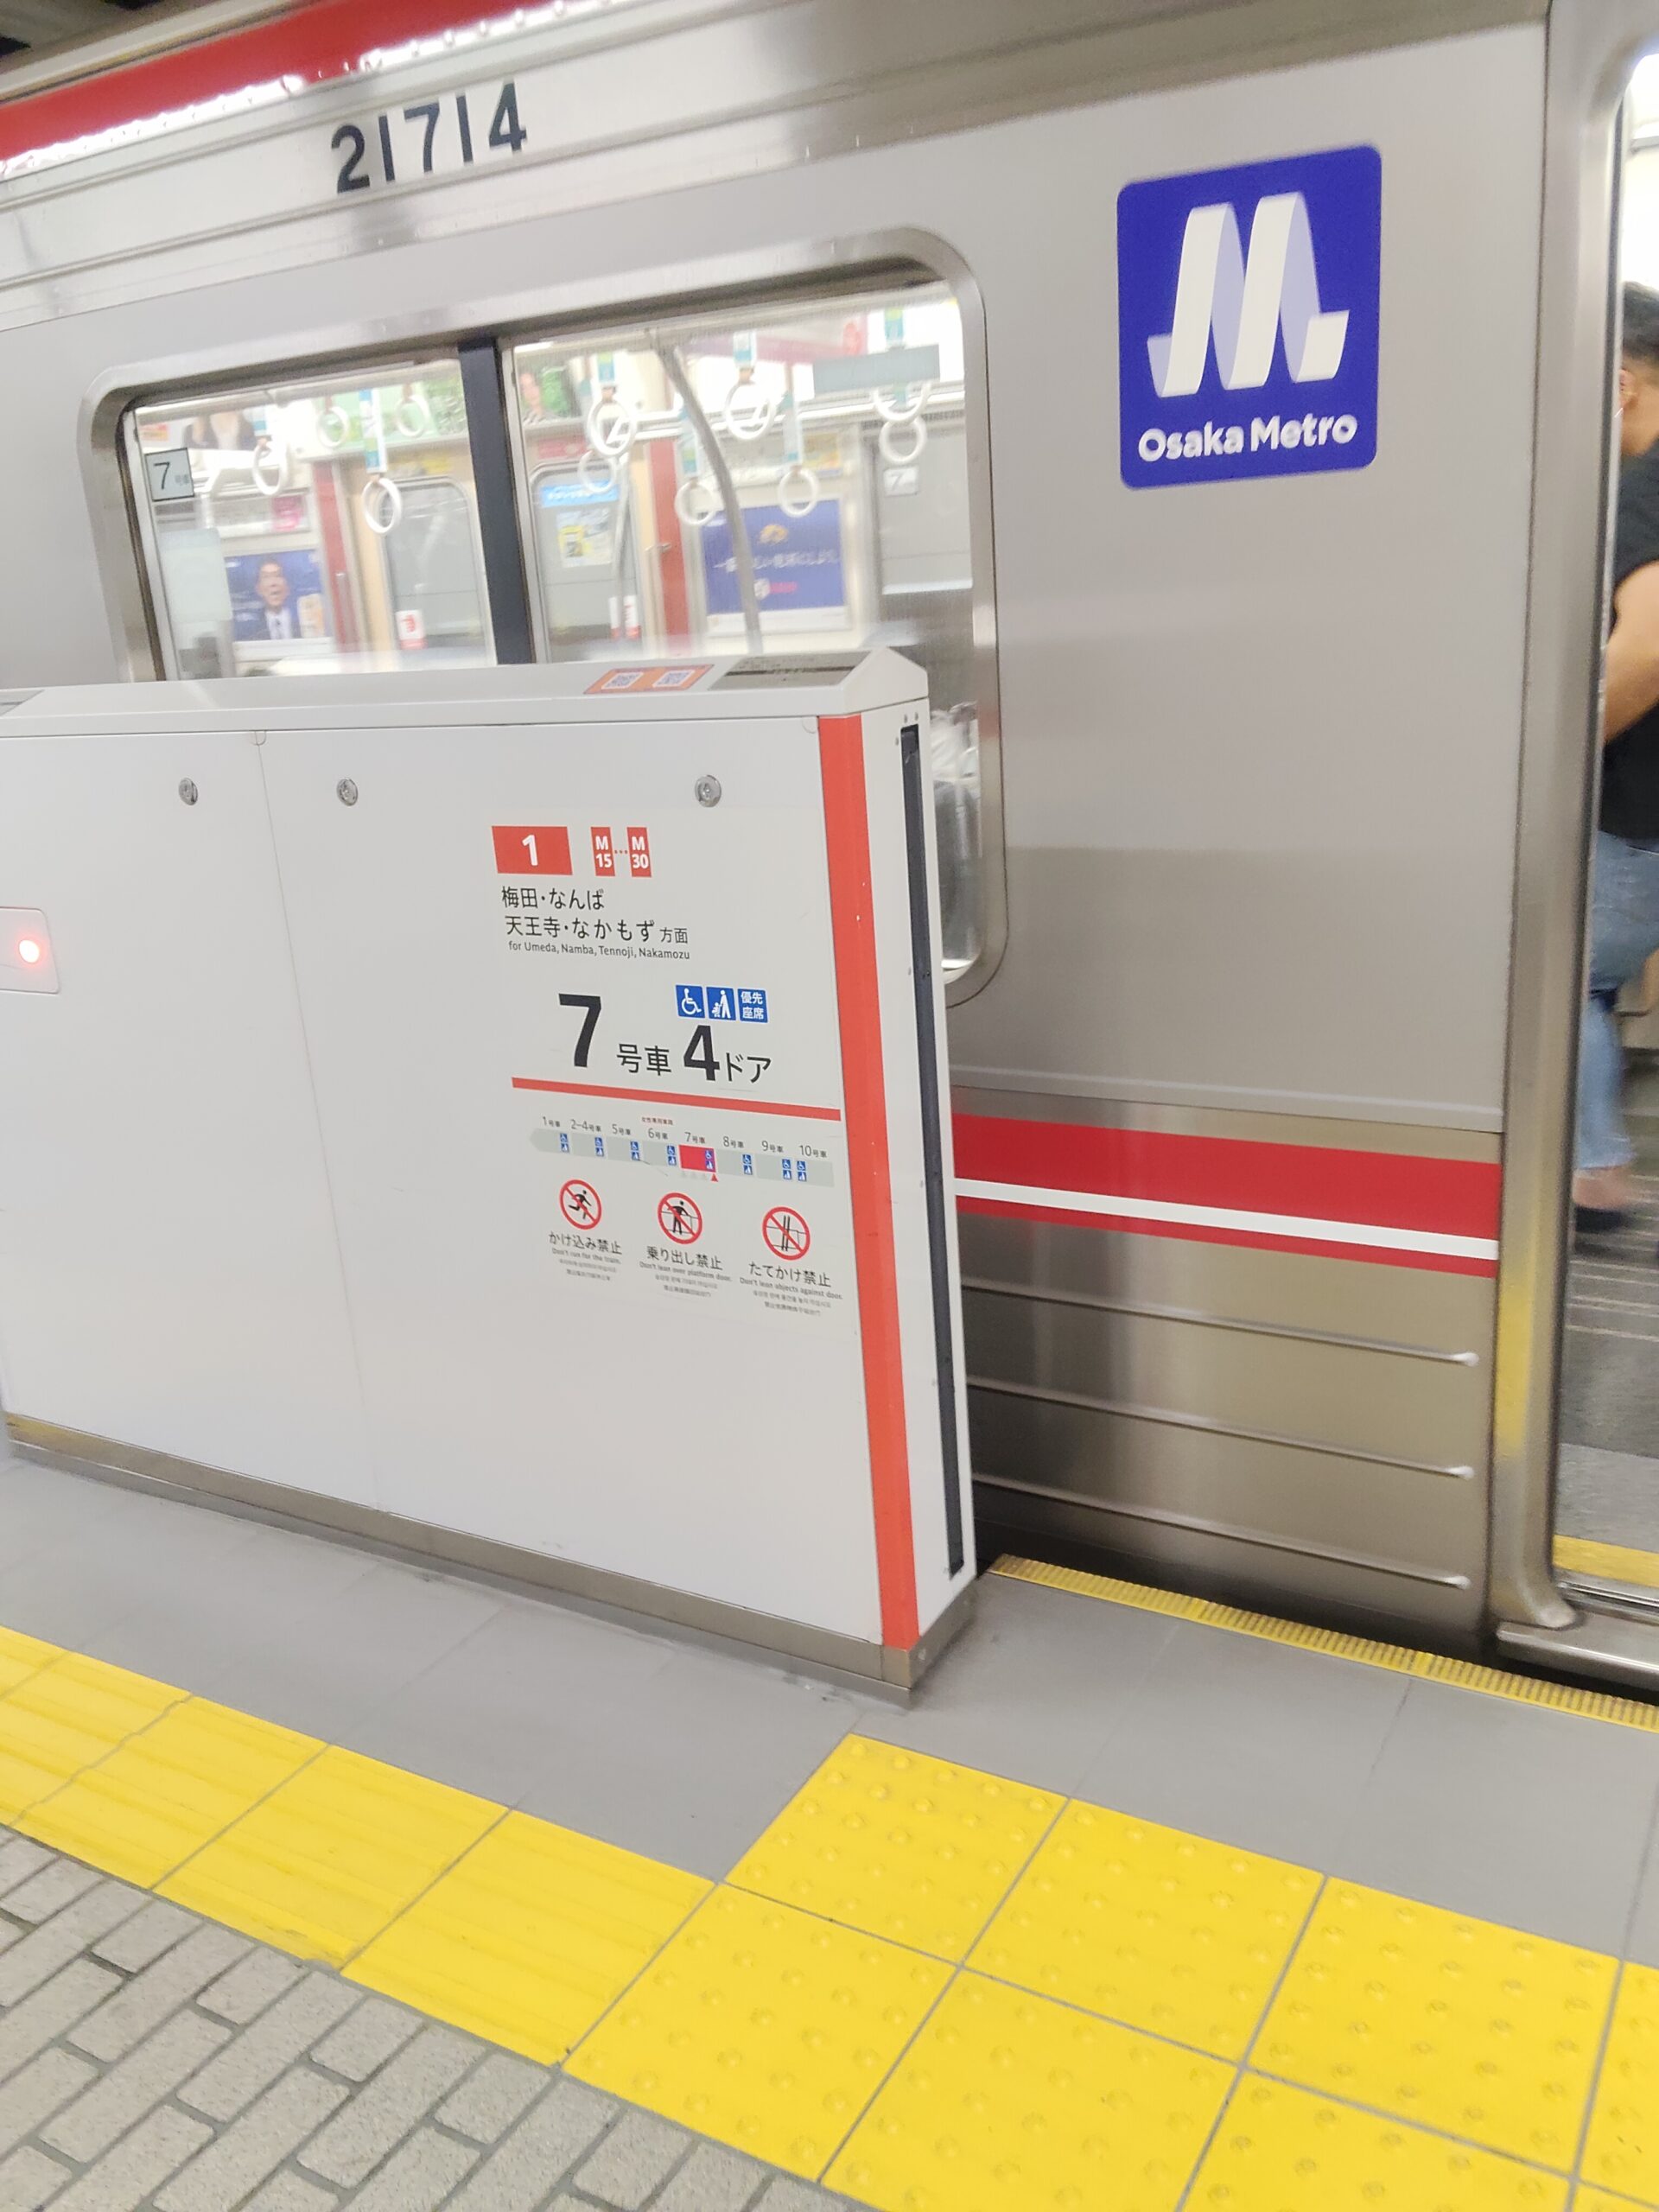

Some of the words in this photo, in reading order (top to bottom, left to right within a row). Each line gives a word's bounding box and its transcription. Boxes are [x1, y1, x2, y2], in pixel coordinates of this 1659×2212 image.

[331, 80, 527, 194] 21714
[1138, 421, 1244, 461] Osaka
[1250, 413, 1357, 452] Metro
[522, 834, 538, 868] 1
[595, 836, 609, 851] M
[632, 836, 645, 851] M
[596, 854, 613, 868] 15
[632, 855, 649, 869] 30
[659, 927, 688, 944] 方面
[509, 941, 521, 951] for
[524, 942, 560, 954] Umeda,
[562, 944, 597, 957] Namba,
[598, 945, 637, 959] Tennoji,
[639, 948, 690, 960] Nakamozu
[549, 1230, 622, 1255] かけ込み禁止
[646, 1245, 723, 1270] 乗り出し禁止
[748, 1262, 831, 1287] たてかけ禁止
